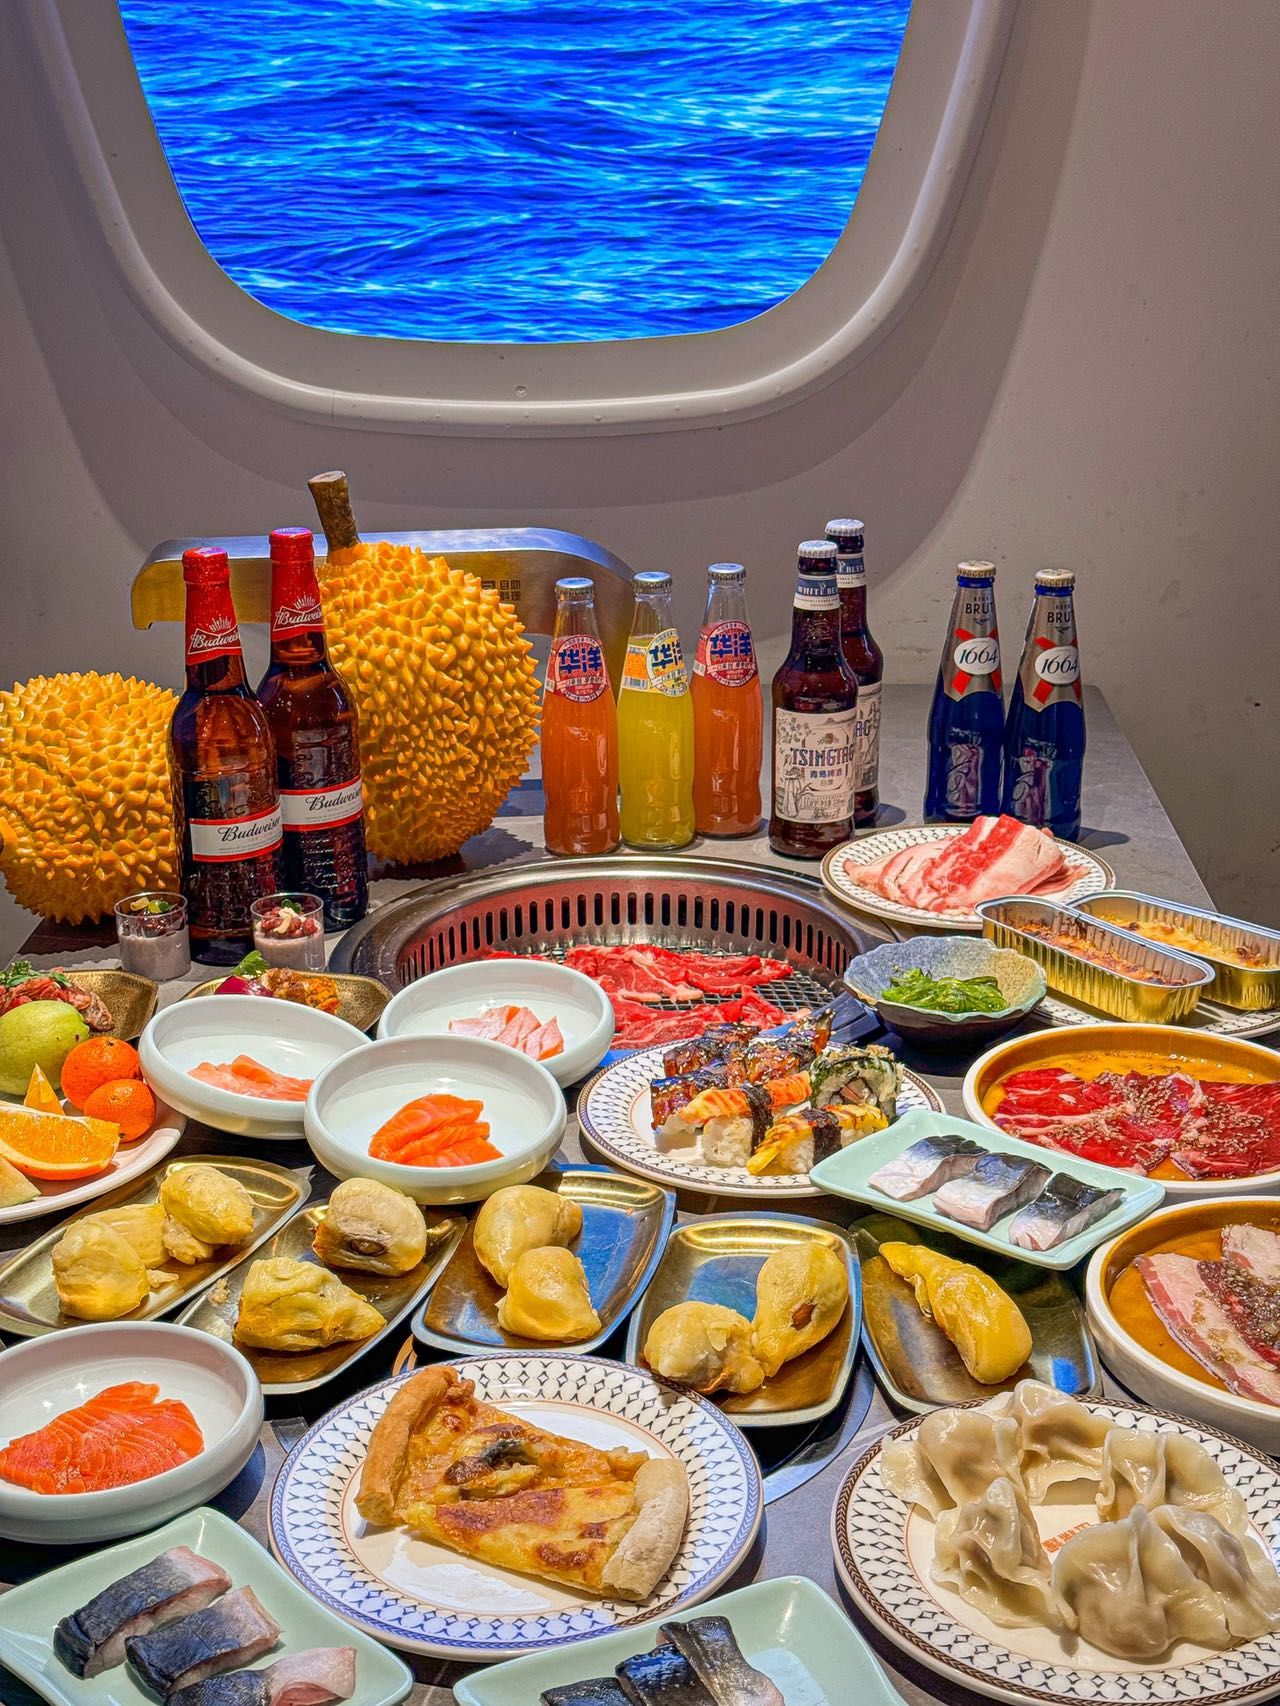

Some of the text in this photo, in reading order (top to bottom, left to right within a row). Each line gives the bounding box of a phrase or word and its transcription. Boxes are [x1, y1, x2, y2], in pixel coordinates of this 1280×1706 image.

[709, 632, 752, 658] 华洋
[959, 644, 998, 665] 1664
[558, 645, 602, 674] 华洋
[1041, 654, 1079, 675] 1664
[217, 816, 281, 842] Budweiser
